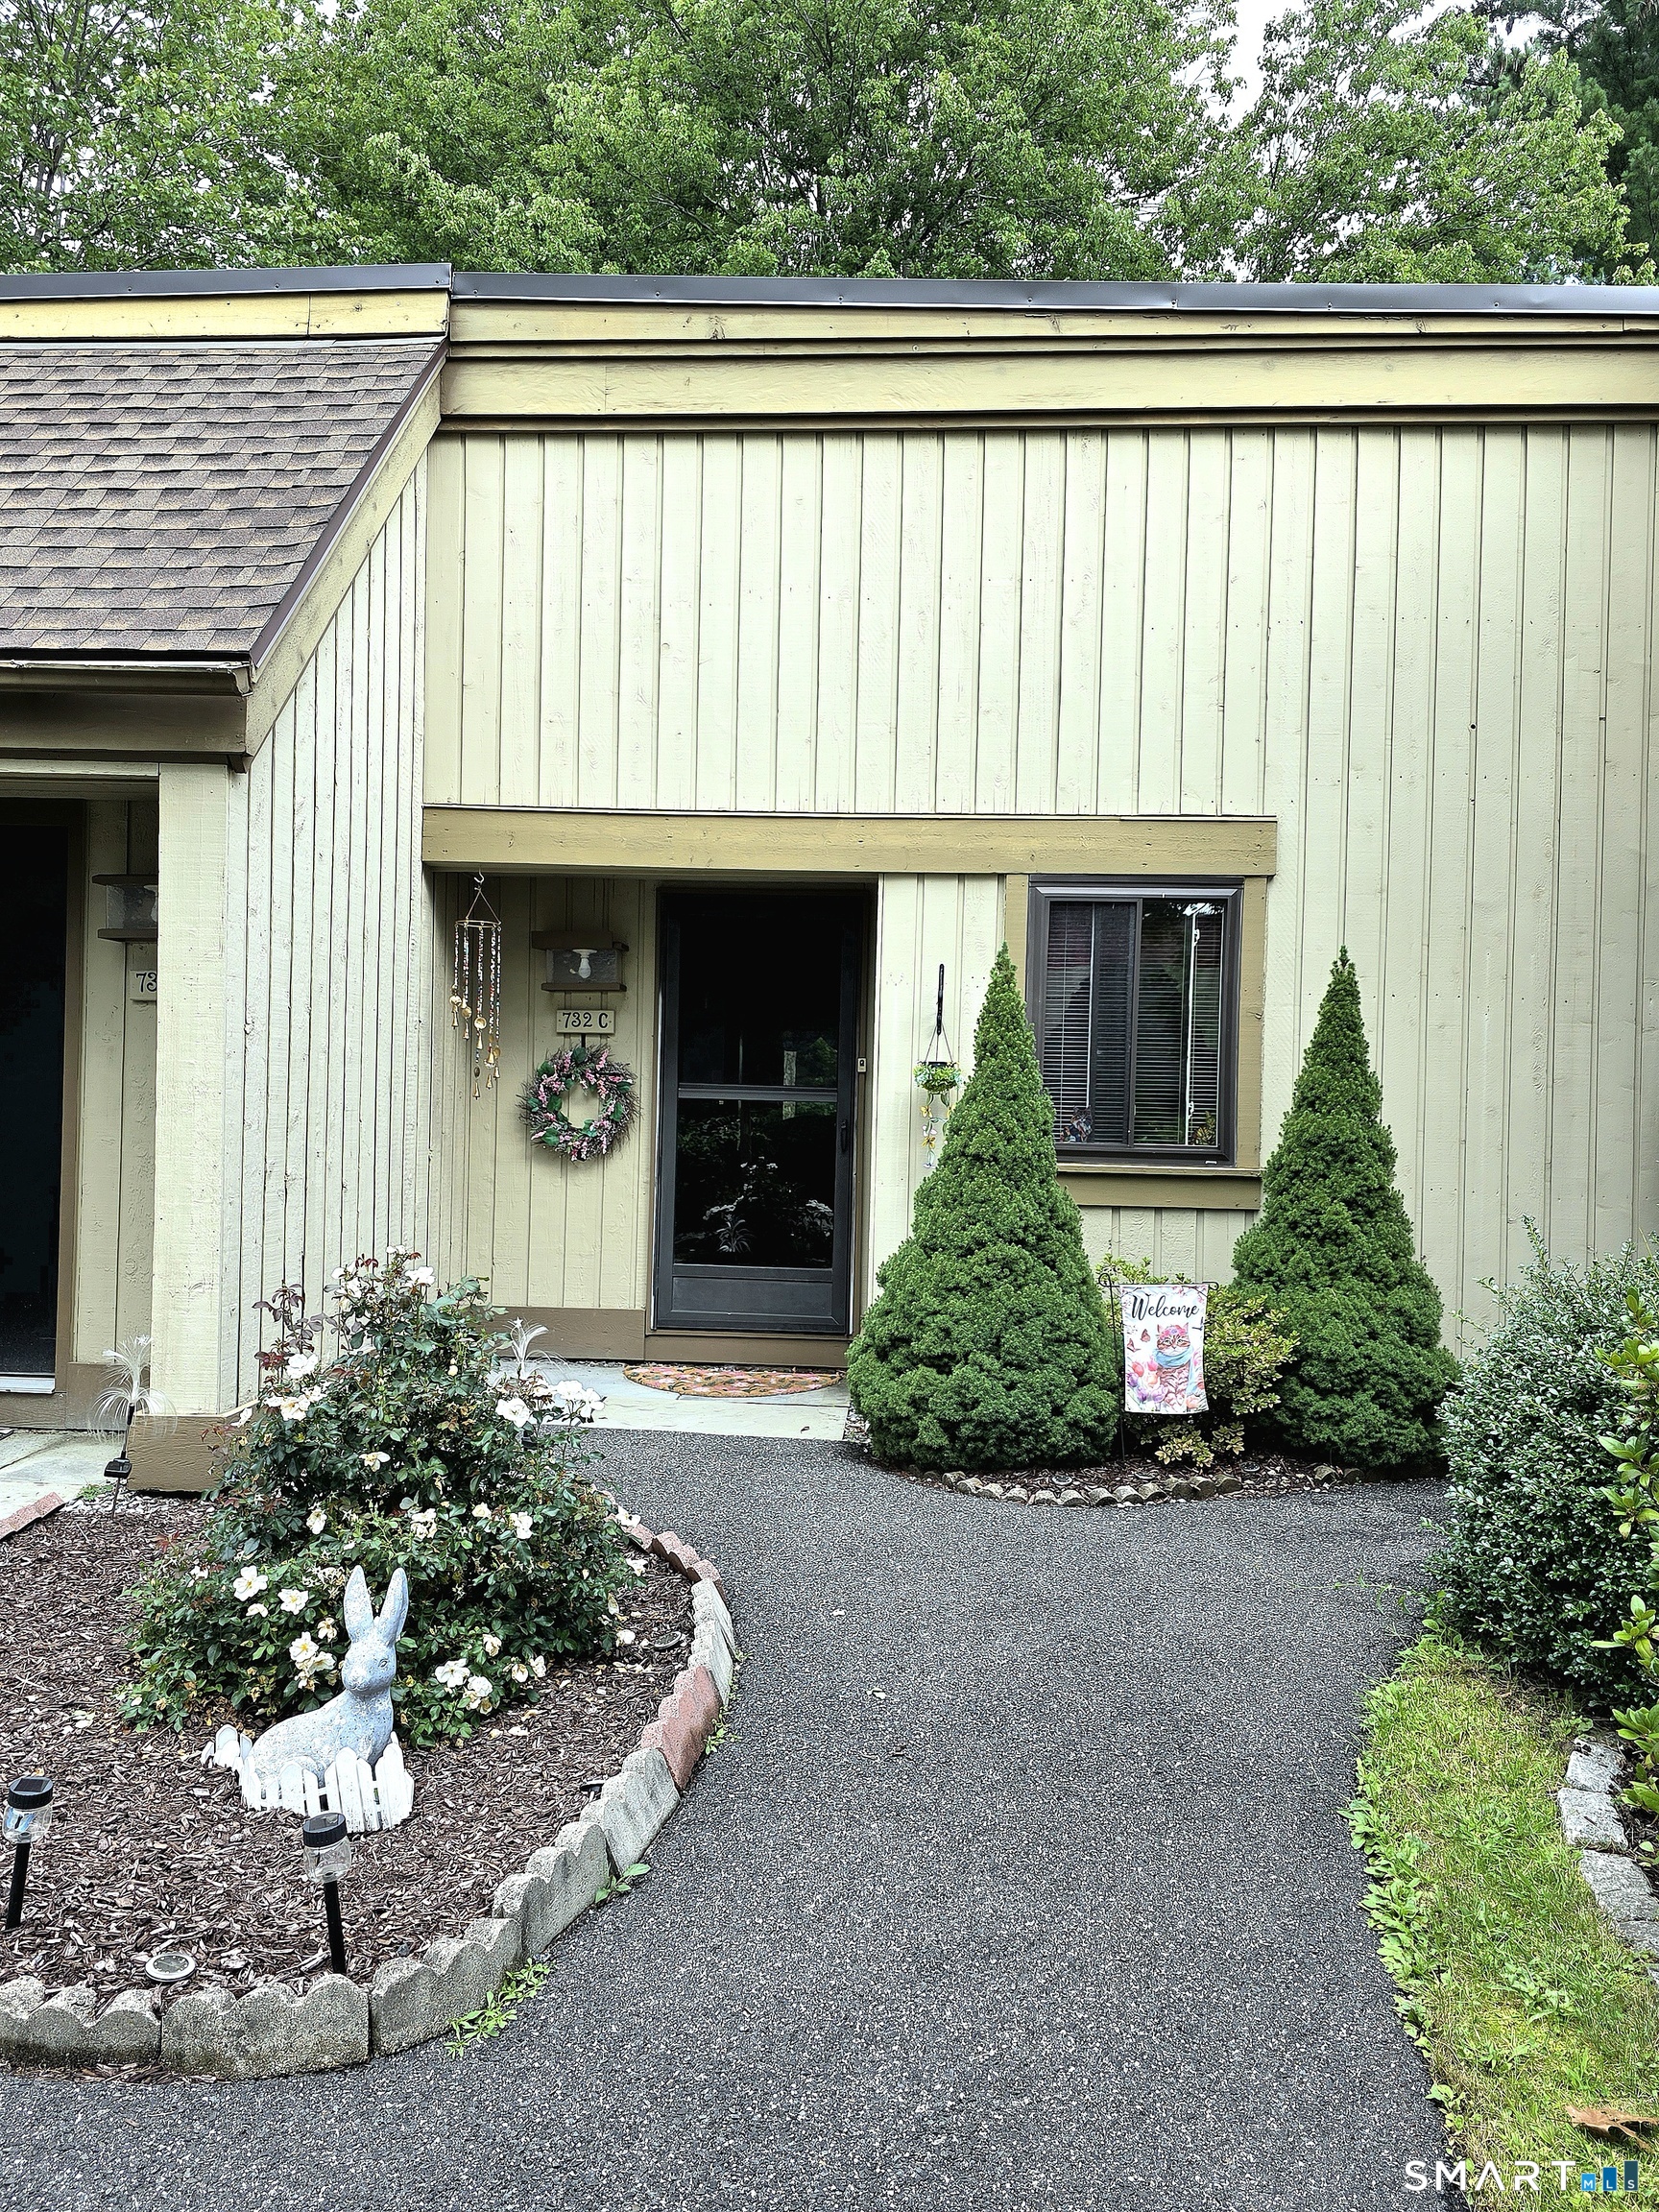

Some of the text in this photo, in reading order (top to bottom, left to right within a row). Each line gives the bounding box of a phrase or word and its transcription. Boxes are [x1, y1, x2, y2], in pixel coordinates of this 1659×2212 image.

[135, 972, 157, 993] 73
[562, 1012, 609, 1029] 732 C
[1131, 1294, 1200, 1321] Welcome
